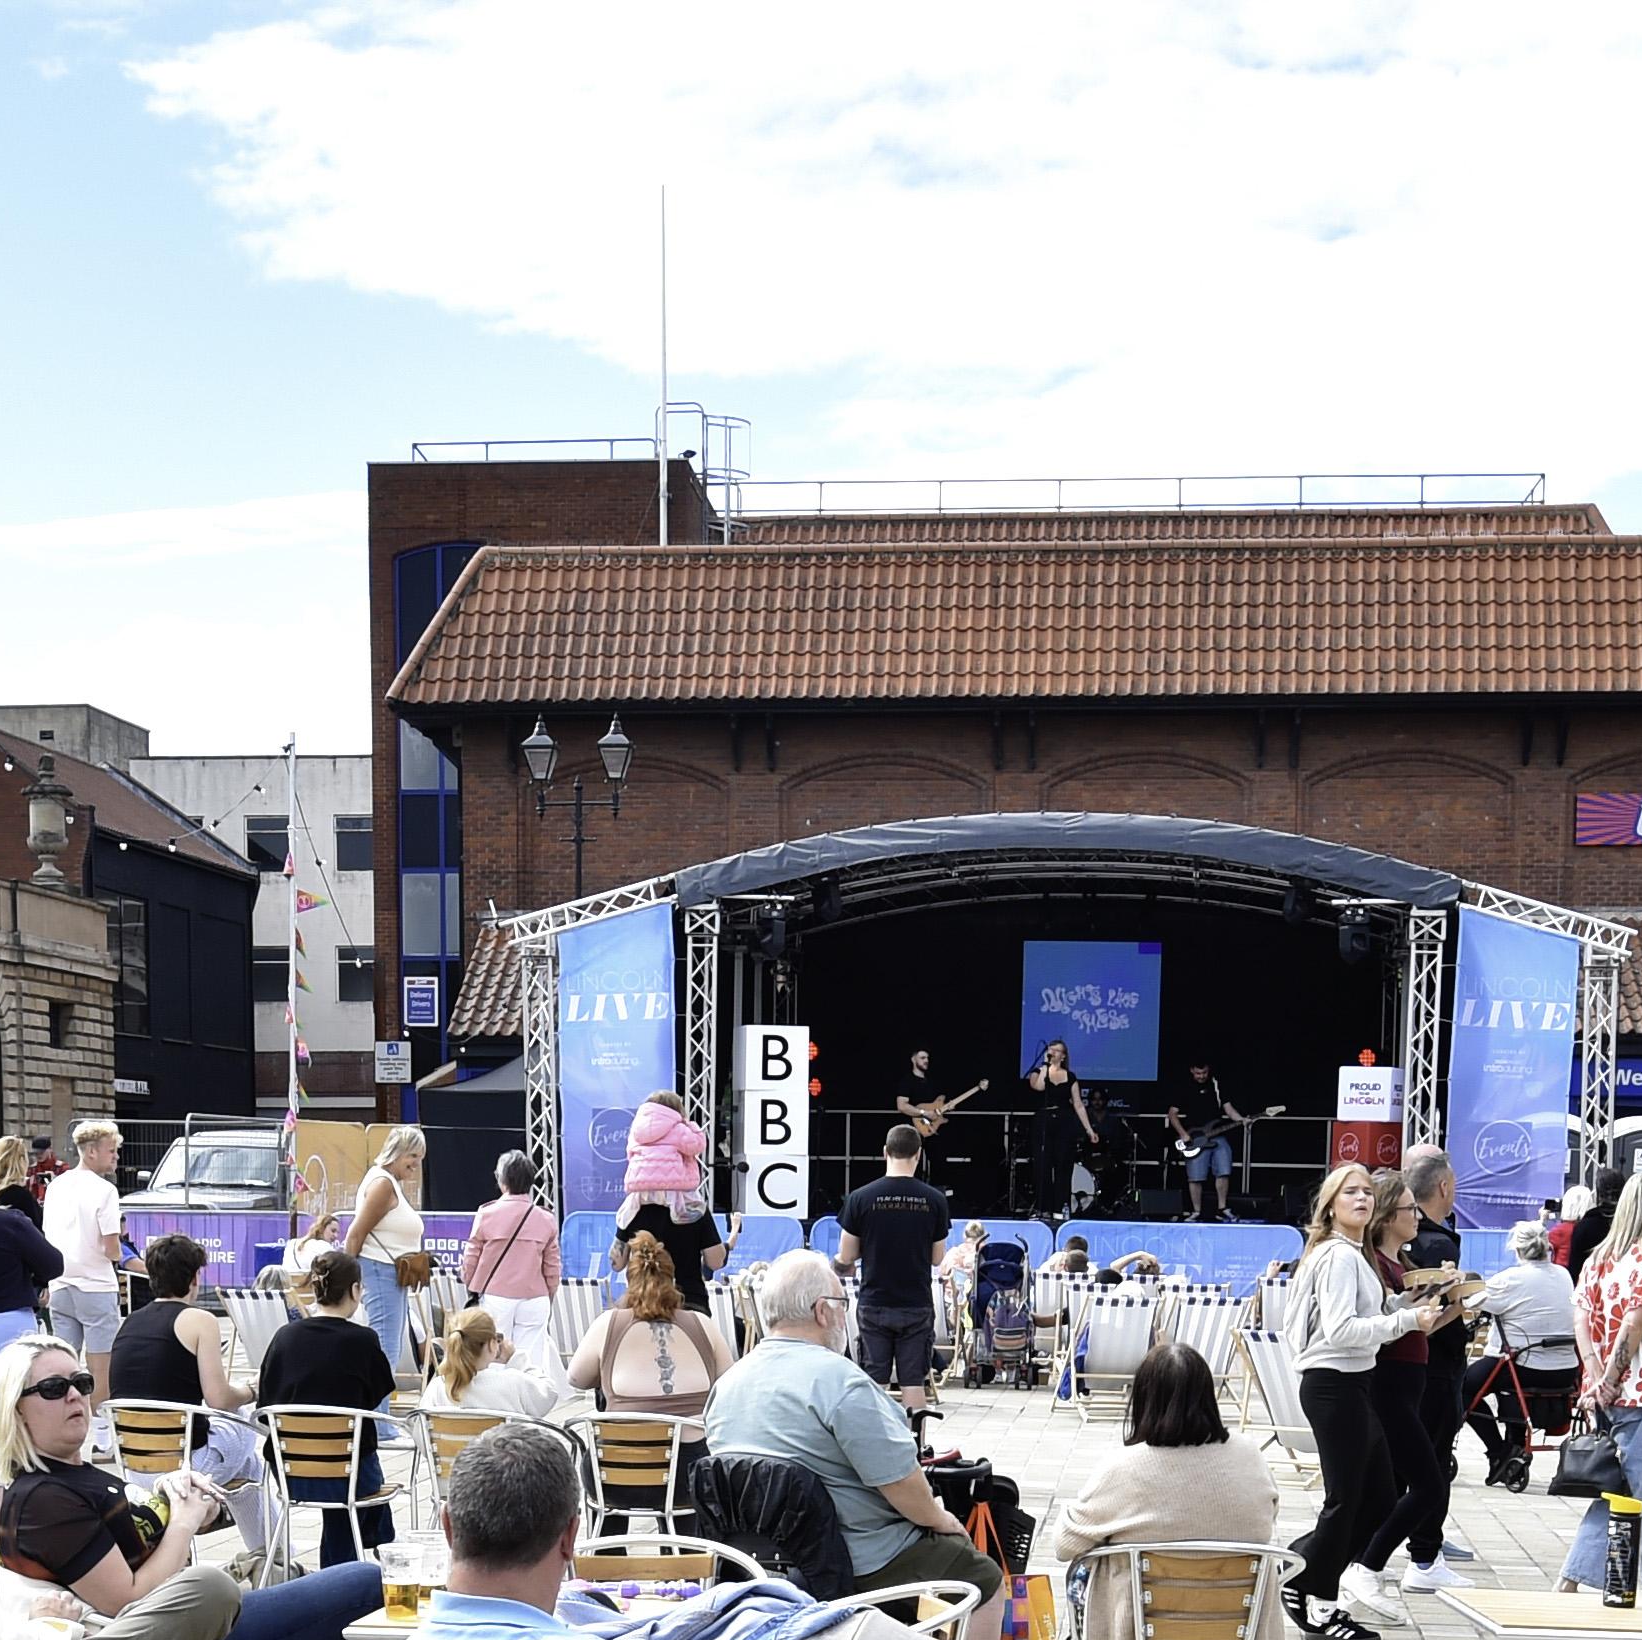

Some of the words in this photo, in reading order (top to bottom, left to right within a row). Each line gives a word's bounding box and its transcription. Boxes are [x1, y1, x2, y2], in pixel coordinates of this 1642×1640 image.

[566, 970, 669, 992] LINCOLN
[1462, 976, 1572, 999] LINCOLN
[409, 991, 432, 999] Delivery
[565, 991, 670, 1022] LIVE
[1460, 998, 1571, 1031] LIVE
[761, 1034, 793, 1081] B
[1349, 1082, 1382, 1091] PROUD
[1343, 1097, 1385, 1105] LINCOLN
[760, 1098, 792, 1145] B
[1478, 1134, 1533, 1161] Events
[757, 1162, 798, 1210] C
[424, 1238, 459, 1251] BBC
[1093, 1235, 1202, 1260] INCOLN
